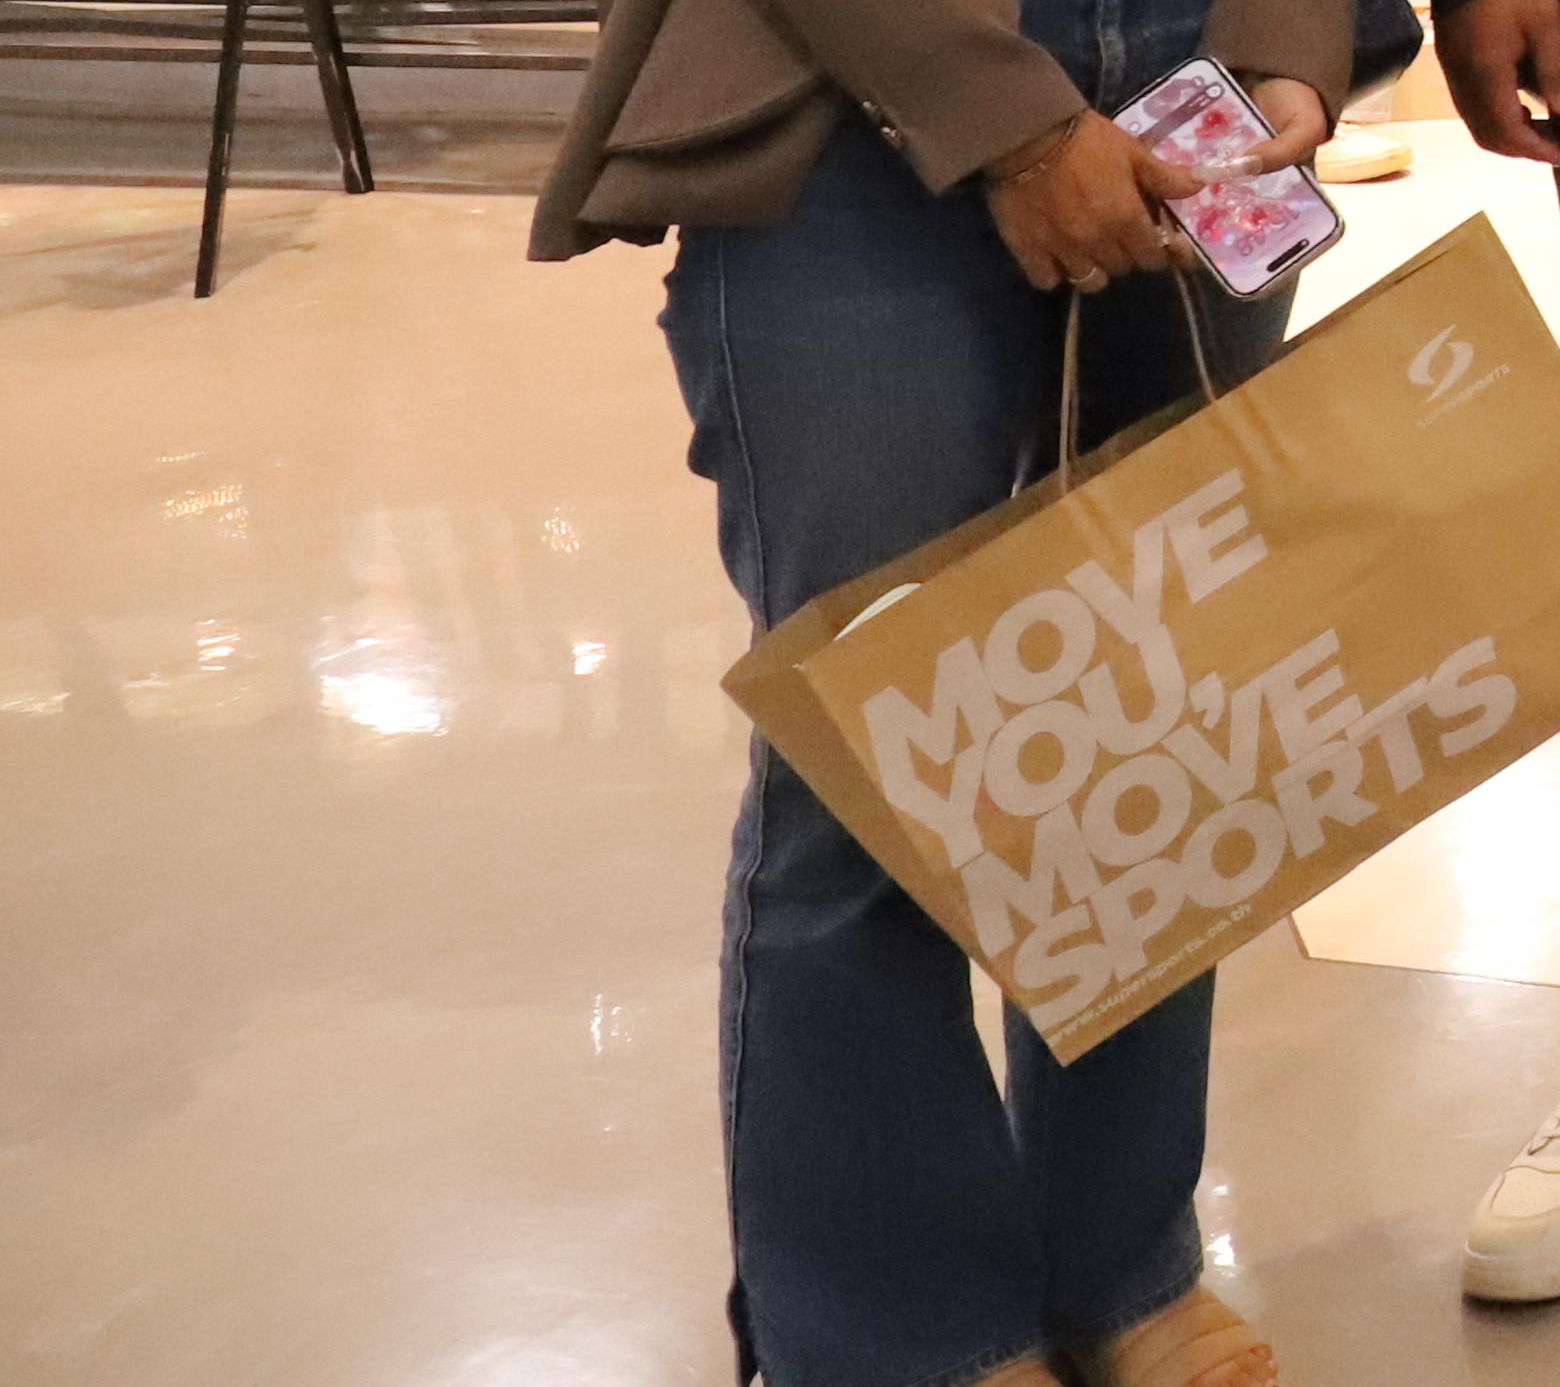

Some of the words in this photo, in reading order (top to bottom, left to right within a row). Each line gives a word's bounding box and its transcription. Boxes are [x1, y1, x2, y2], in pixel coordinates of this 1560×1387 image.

[862, 467, 1269, 785] MOVE
[958, 628, 1365, 959] MOVE
[1014, 634, 1518, 1029] SPORTS
